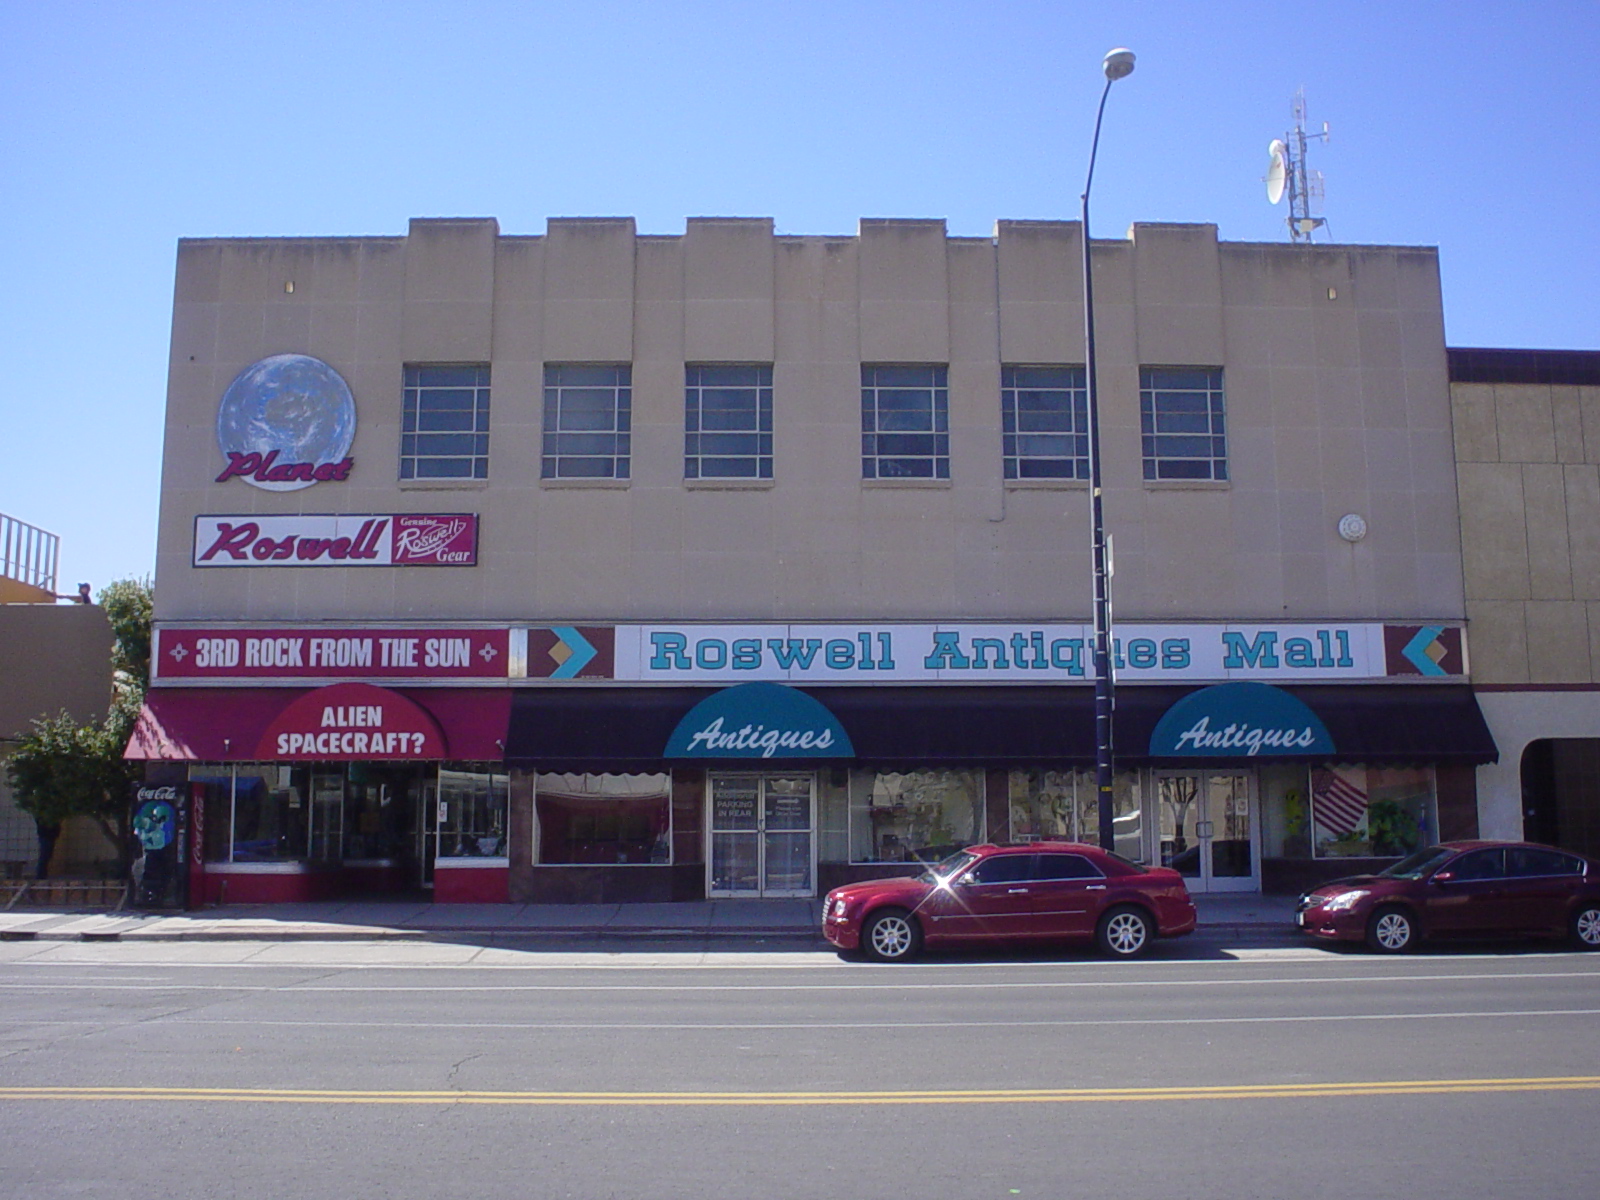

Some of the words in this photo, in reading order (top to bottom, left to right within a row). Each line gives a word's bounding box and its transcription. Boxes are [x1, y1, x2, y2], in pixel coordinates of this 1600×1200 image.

[215, 449, 354, 482] Planet
[400, 517, 437, 526] Genuine
[198, 518, 389, 561] Roswell
[395, 518, 459, 560] Roswell
[436, 548, 470, 562] Gear
[195, 638, 239, 667] 3RD
[245, 638, 303, 667] ROCK
[309, 638, 372, 667] FROM
[379, 638, 419, 667] THE
[424, 638, 470, 667] SUN
[650, 632, 895, 670] Roswell
[1222, 630, 1353, 668] Mall
[320, 706, 382, 727] ALIEN
[277, 732, 425, 754] SPACECRAFT?
[687, 716, 834, 758] Antiques
[1174, 716, 1315, 756] Antiques
